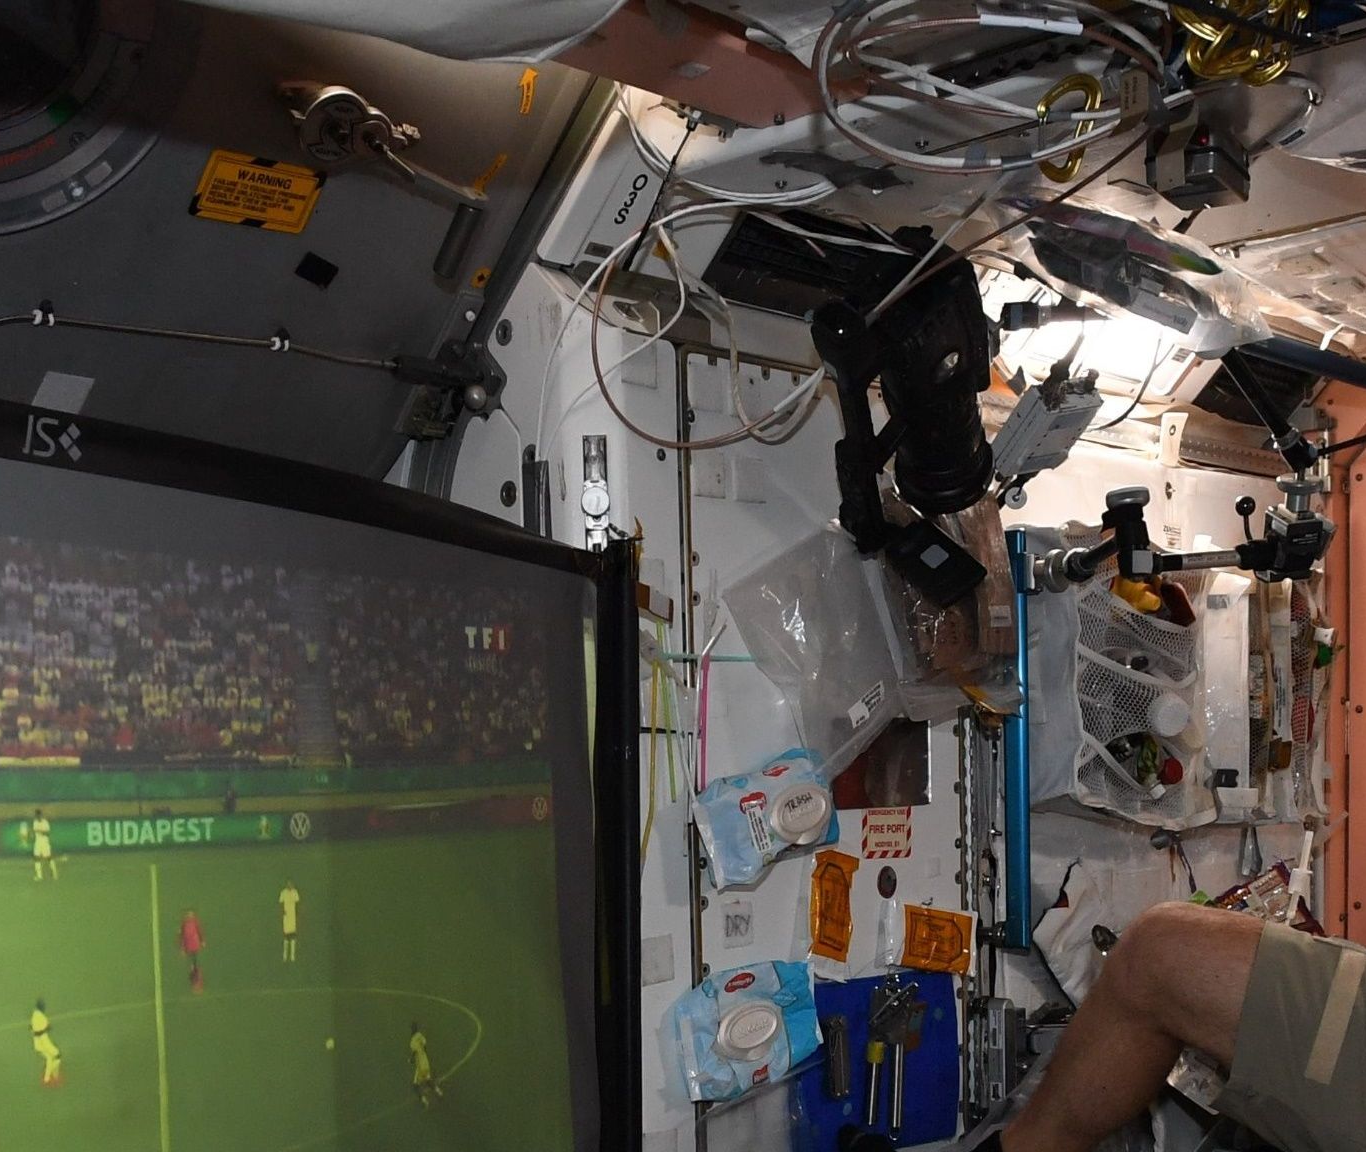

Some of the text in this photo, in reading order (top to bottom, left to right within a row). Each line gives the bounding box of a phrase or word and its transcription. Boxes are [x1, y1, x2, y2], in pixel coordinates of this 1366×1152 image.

[237, 170, 292, 190] WARNING
[785, 792, 813, 813] TRASH
[86, 817, 215, 846] BUDAPEST
[869, 824, 906, 834] FIRE PORT
[726, 914, 751, 938] DRY
